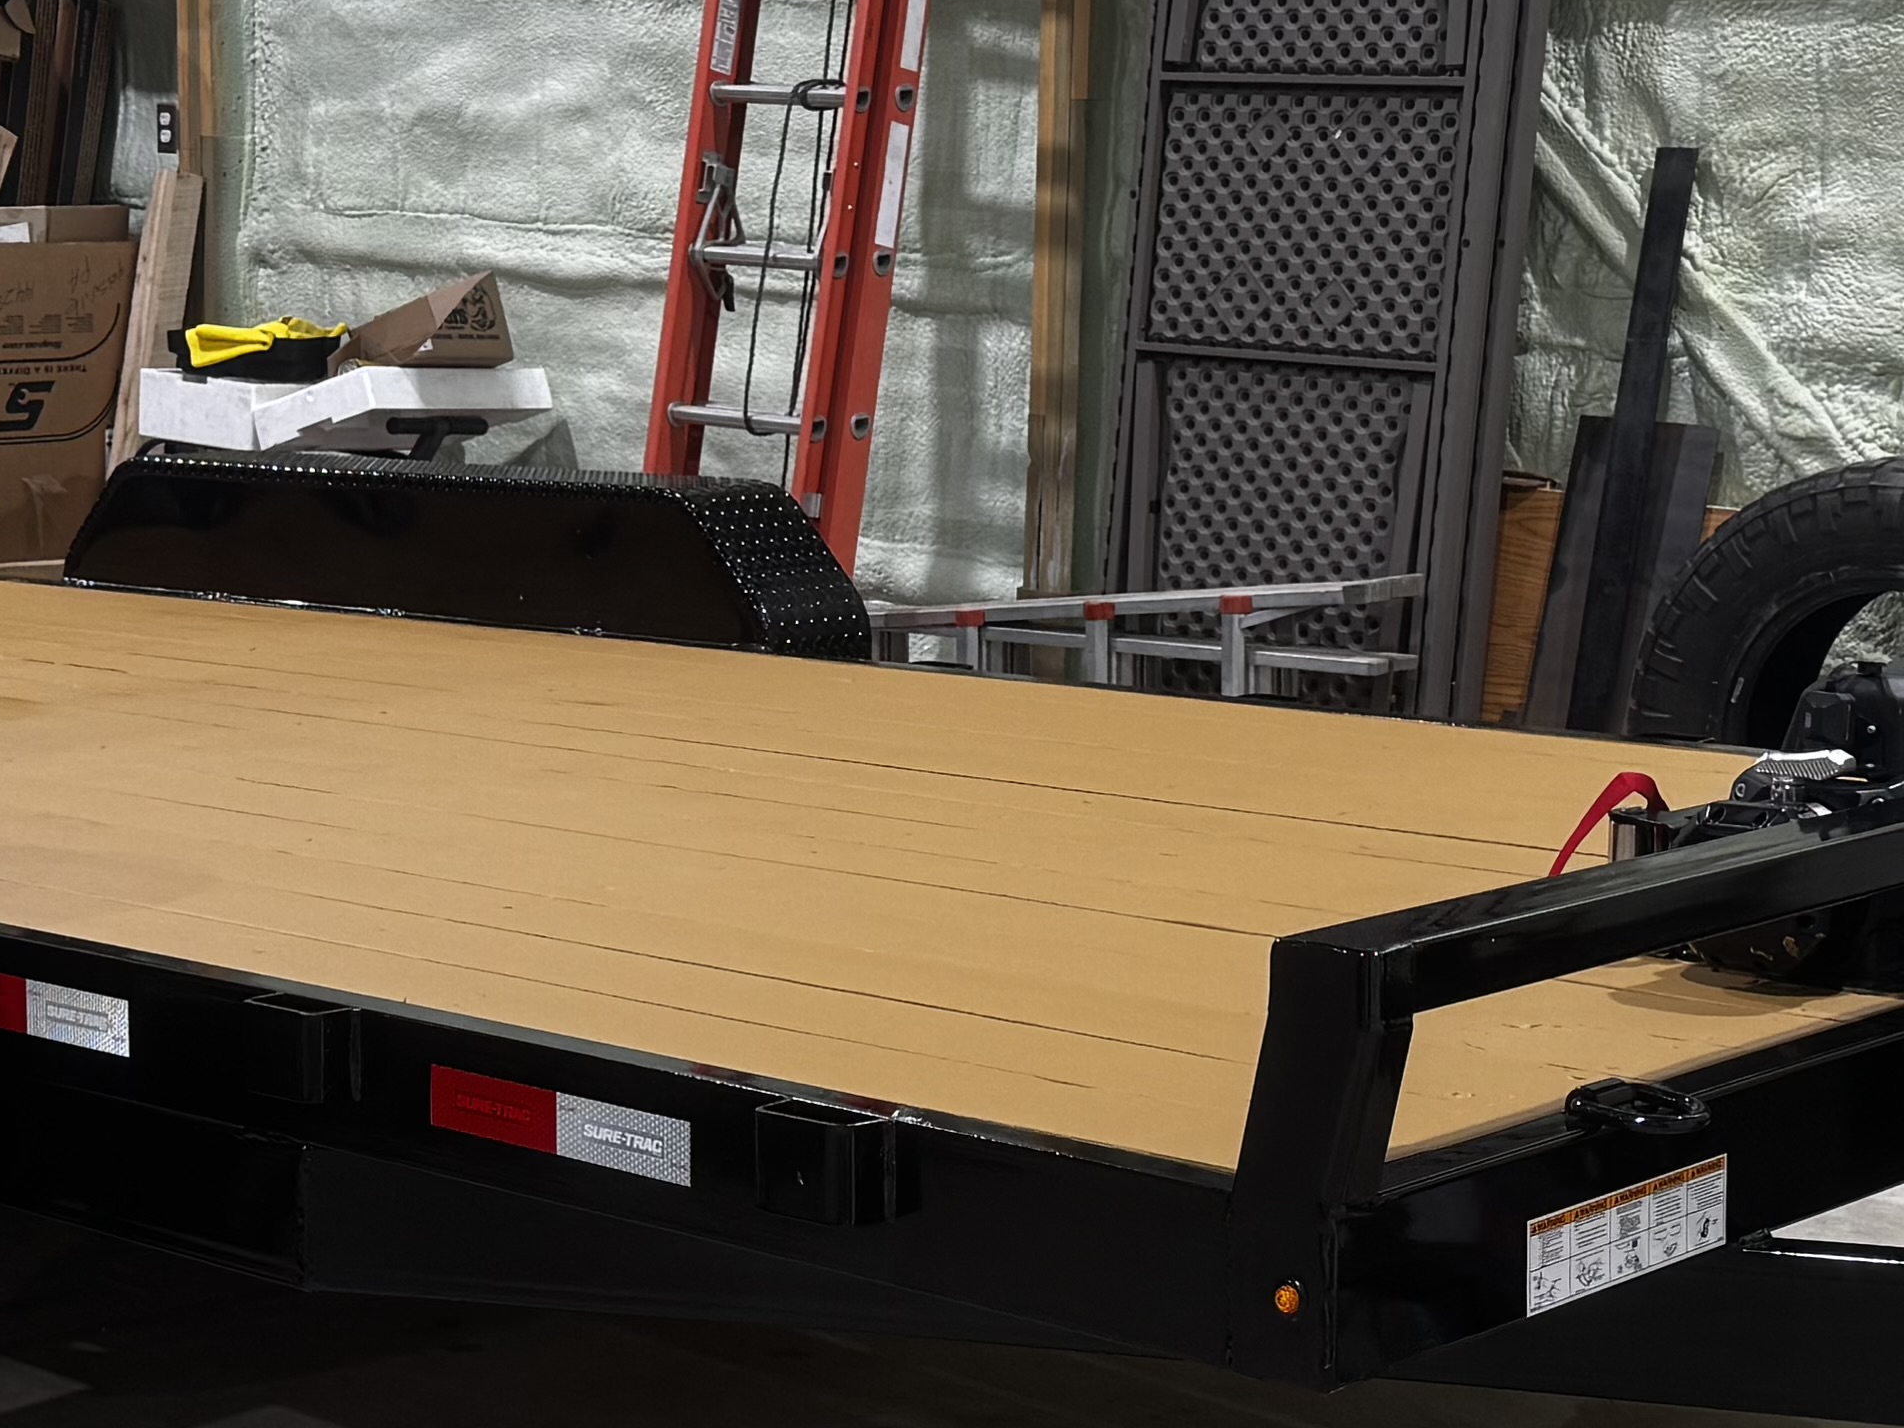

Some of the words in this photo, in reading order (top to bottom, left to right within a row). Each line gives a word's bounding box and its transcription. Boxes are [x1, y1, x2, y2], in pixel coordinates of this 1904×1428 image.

[43, 366, 53, 374] IS
[57, 364, 87, 373] THERE
[456, 1094, 533, 1122] SURE-TRAC
[583, 1123, 663, 1154] SURE-TRAC
